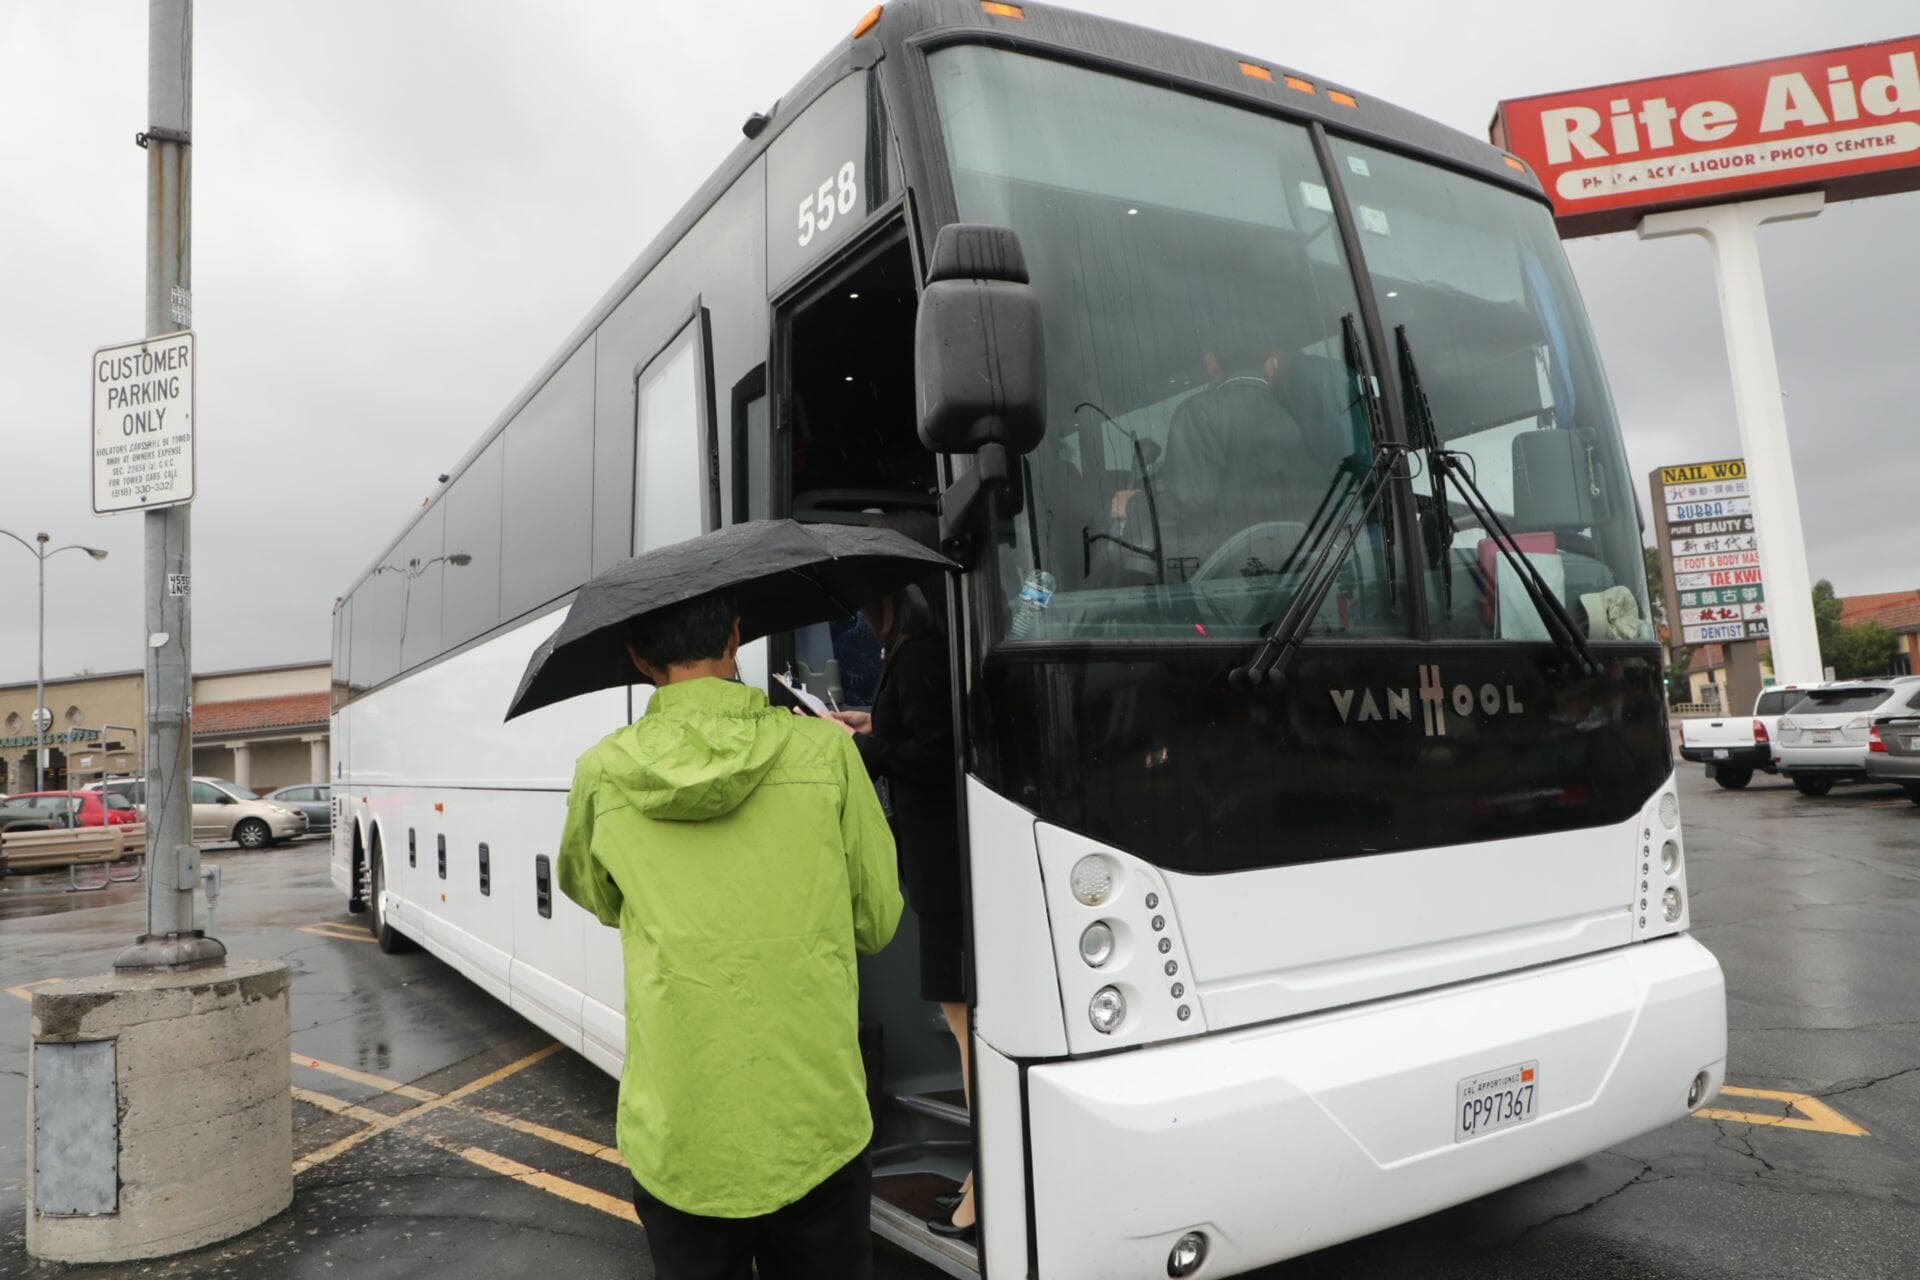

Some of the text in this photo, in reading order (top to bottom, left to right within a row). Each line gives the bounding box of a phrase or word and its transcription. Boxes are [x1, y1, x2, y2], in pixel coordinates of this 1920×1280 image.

[1540, 51, 1920, 165] Rite Aid
[1582, 134, 1896, 190] PHACY LIQUOR PHOTO CENTER
[798, 161, 857, 247] 558
[98, 345, 189, 382] CUSTOMER
[108, 376, 180, 410] PARKING
[123, 407, 166, 436] ONLY
[96, 444, 128, 457] VIOLATORS
[172, 433, 191, 444] TOWED
[109, 478, 120, 487] FOR
[123, 475, 143, 486] TOWED
[1663, 466, 1708, 483] NAIL
[112, 481, 173, 498] (818) 330-332
[1676, 502, 1723, 519] BUBBA
[1670, 525, 1692, 535] PURE
[1694, 519, 1741, 535] BEAUTY
[1684, 556, 1706, 569] FOOT
[1709, 555, 1715, 567] &
[1717, 553, 1740, 566] BODY
[1708, 570, 1732, 586] TAE
[1701, 624, 1742, 639] DENTIST
[1463, 1084, 1534, 1131] CP97367
